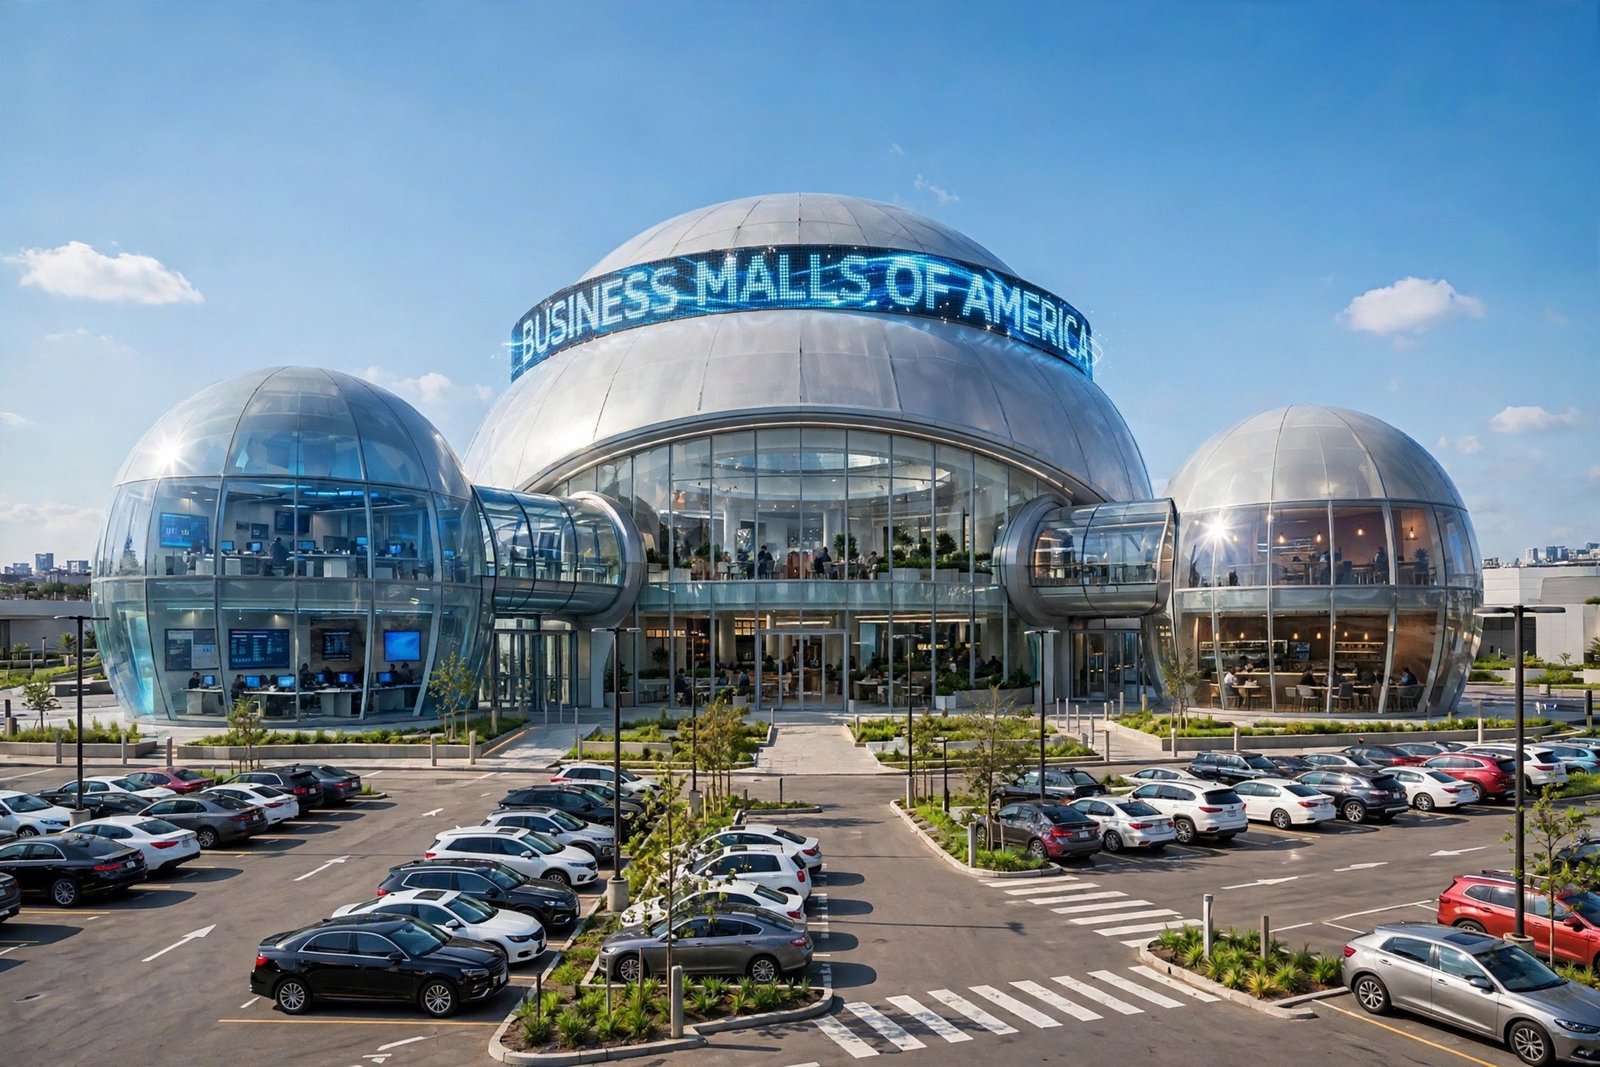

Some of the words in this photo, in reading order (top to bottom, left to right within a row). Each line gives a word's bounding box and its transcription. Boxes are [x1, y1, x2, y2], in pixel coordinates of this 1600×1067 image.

[522, 266, 678, 364] BUSINESS
[696, 254, 870, 306] MALLS
[886, 256, 950, 309] OF
[962, 273, 1090, 369] AMERICA
